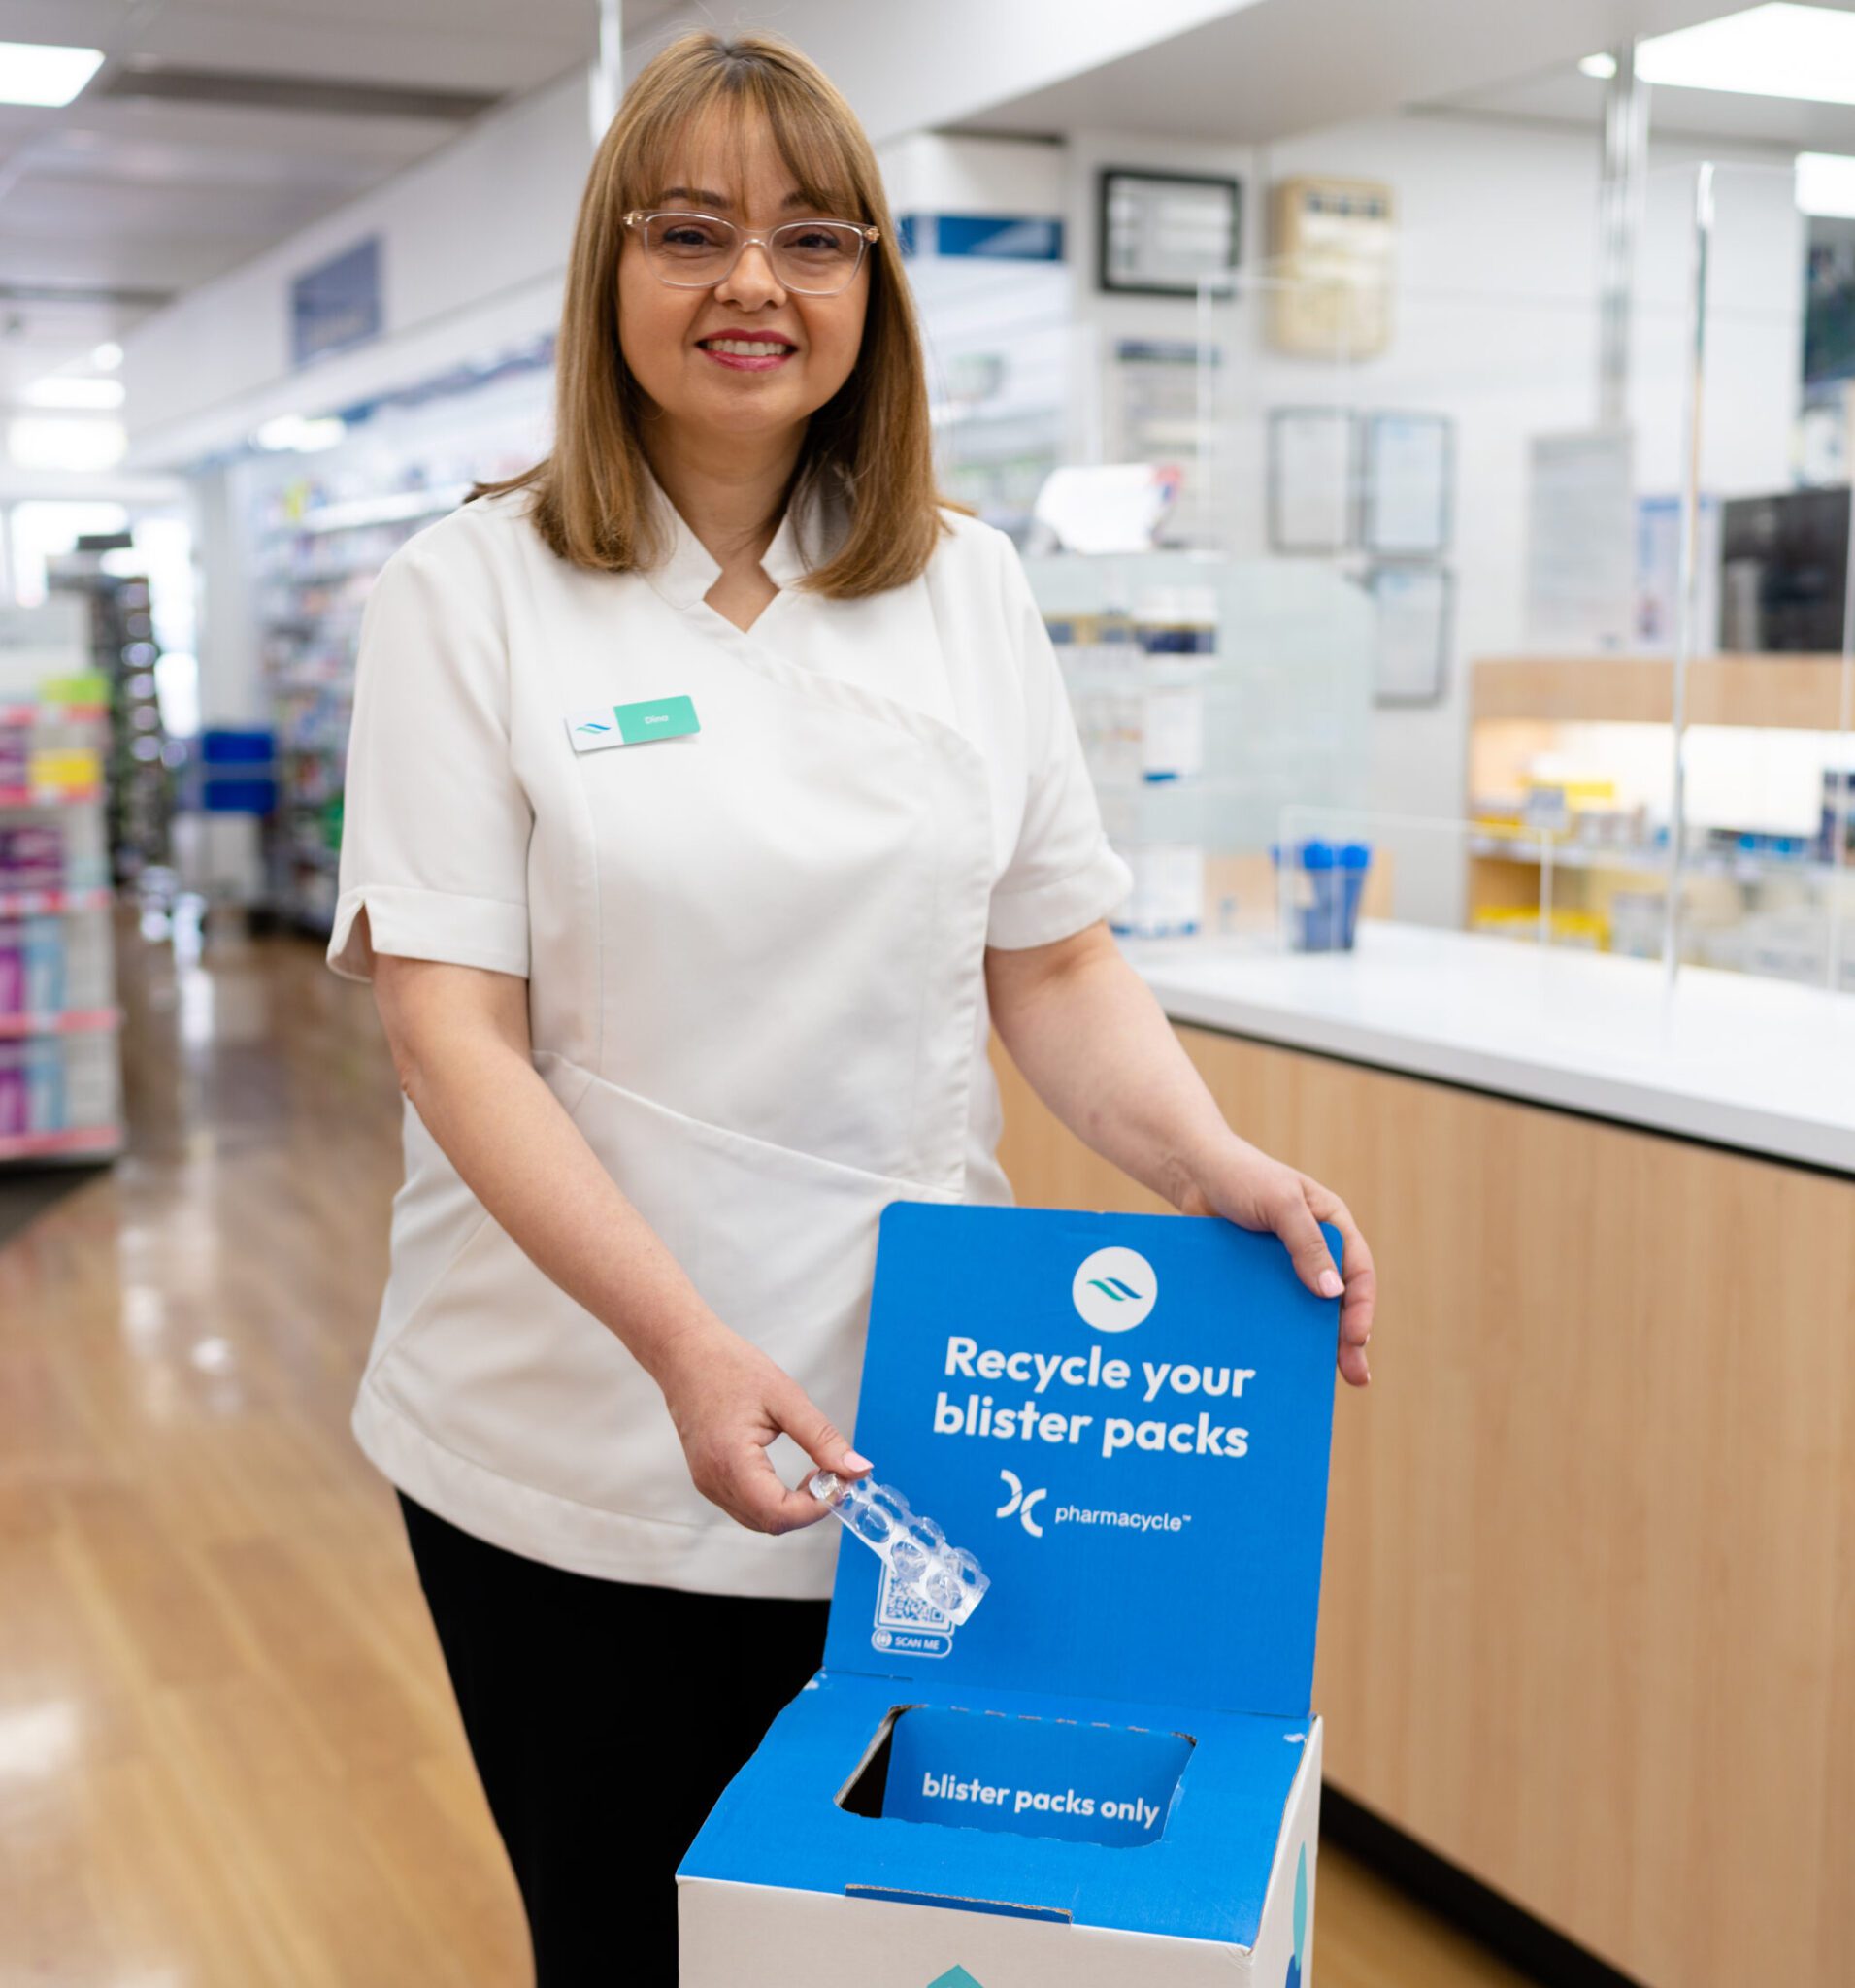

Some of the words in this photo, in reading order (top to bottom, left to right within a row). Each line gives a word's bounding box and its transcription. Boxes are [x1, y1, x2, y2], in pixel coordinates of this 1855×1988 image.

[945, 1336, 1131, 1394] Recycle
[1143, 1362, 1256, 1403] your
[933, 1392, 1093, 1444] blister
[1102, 1413, 1249, 1458] packs
[894, 1636, 922, 1648] SCAN
[923, 1639, 940, 1650] ME
[922, 1772, 1010, 1806] blister
[1014, 1789, 1095, 1816] packs
[1100, 1797, 1161, 1829] only
